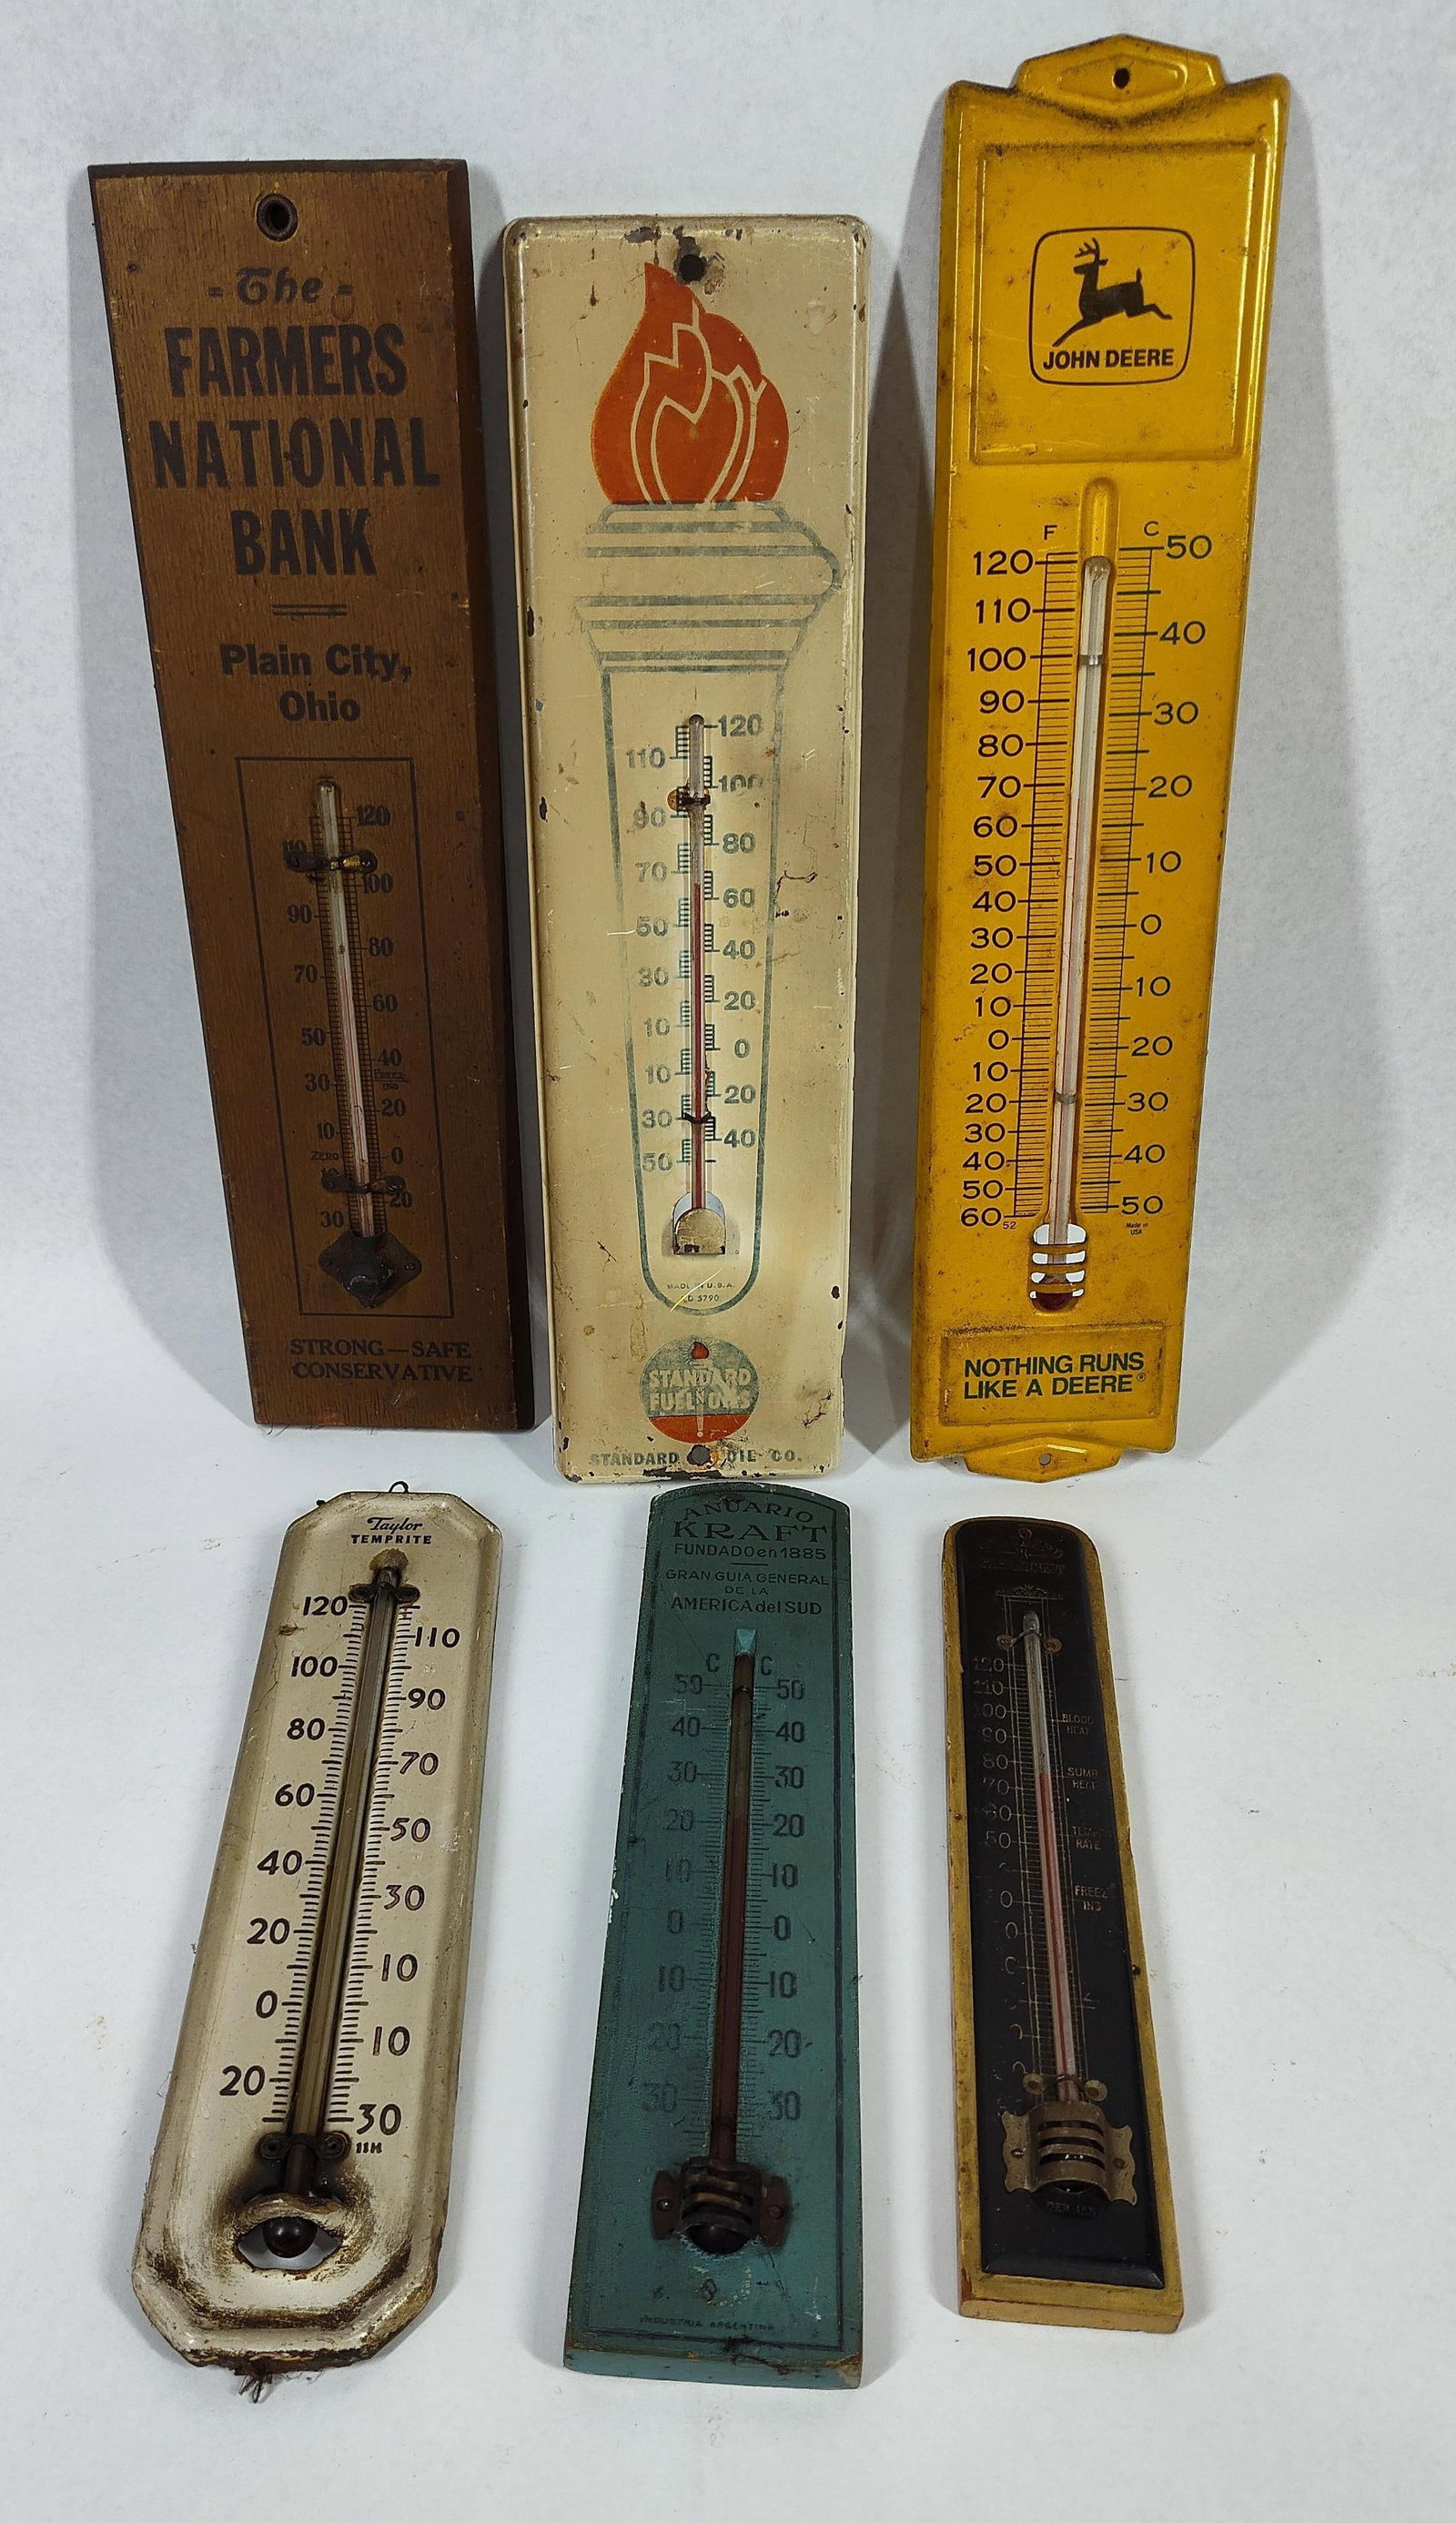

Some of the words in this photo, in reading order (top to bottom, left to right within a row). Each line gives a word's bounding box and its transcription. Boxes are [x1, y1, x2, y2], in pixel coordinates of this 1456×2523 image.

[237, 268, 323, 304] The
[165, 324, 408, 397] FARMERS
[1043, 350, 1100, 370] JOHN
[1105, 349, 1174, 368] DEERE
[148, 418, 441, 489] NATIONAL
[1044, 525, 1057, 540] F
[1144, 521, 1158, 536] C
[230, 509, 378, 576] BANK
[1166, 535, 1212, 560] 50
[973, 549, 1034, 575] 120
[976, 598, 1031, 623] 110
[1159, 621, 1206, 645] 40
[221, 644, 311, 676] Plain
[326, 644, 412, 684] City,
[967, 647, 1026, 672] 100
[279, 691, 361, 723] Ohio
[979, 690, 1025, 714] 90
[1153, 701, 1198, 724] 30
[718, 714, 762, 737] 120
[977, 734, 1024, 757] 80
[626, 747, 666, 769] 110
[977, 775, 1021, 799] 70
[1148, 775, 1192, 798] 20
[357, 805, 390, 826] 120
[633, 806, 666, 829] 90
[973, 816, 1017, 838] 60
[723, 832, 756, 854] 80
[635, 862, 667, 882] 70
[974, 855, 1016, 876] 50
[1147, 851, 1181, 874] 10
[364, 874, 393, 893] 100
[723, 887, 755, 908] 60
[972, 890, 1016, 913] 40
[287, 905, 312, 924] 90
[1140, 914, 1161, 935] 0
[637, 917, 668, 937] 50
[369, 937, 393, 957] 80
[970, 927, 1014, 949] 30
[723, 939, 756, 959] 40
[294, 964, 318, 983] 70
[638, 968, 669, 987] 30
[969, 962, 1013, 984] 20
[1137, 977, 1171, 997] 10
[373, 994, 398, 1012] 60
[724, 990, 756, 1010] 20
[975, 997, 1011, 1018] 10
[301, 1028, 326, 1047] 50
[643, 1018, 670, 1037] 10
[734, 1039, 751, 1058] 0
[988, 1029, 1009, 1049] 0
[1131, 1036, 1173, 1057] 20
[379, 1049, 402, 1066] 40
[644, 1064, 671, 1084] 10
[973, 1061, 1008, 1082] 10
[305, 1074, 330, 1091] 30
[724, 1085, 756, 1104] 20
[965, 1093, 1007, 1113] 20
[1127, 1092, 1169, 1112] 30
[381, 1099, 406, 1117] 20
[642, 1109, 672, 1129] 30
[318, 1122, 334, 1139] 10
[723, 1129, 756, 1148] 40
[964, 1123, 1006, 1143] 30
[390, 1147, 404, 1164] 0
[642, 1153, 672, 1170] 50
[962, 1150, 1005, 1171] 40
[1124, 1144, 1165, 1164] 40
[962, 1180, 1003, 1200] 50
[1121, 1196, 1163, 1215] 50
[320, 1211, 344, 1227] 30
[960, 1208, 1001, 1227] 60
[1002, 1221, 1016, 1230] 52
[293, 1362, 473, 1383] CONSERVATIVE
[965, 1354, 1073, 1377] NOTHING
[1079, 1352, 1144, 1372] RUNS
[649, 1369, 751, 1388] STANDARD
[964, 1382, 1017, 1399] LIKE
[1026, 1379, 1043, 1396] A
[650, 1393, 694, 1411] FUEL
[590, 1451, 680, 1466] STANDARD
[683, 1502, 814, 1523] ANUARIO
[367, 1517, 423, 1535] Taylor
[673, 1521, 827, 1542] KRAFT
[351, 1535, 432, 1545] TEMPRITE
[666, 1570, 710, 1581] GRAN
[715, 1572, 752, 1582] GUIA
[756, 1573, 829, 1586] GENERAL
[303, 1596, 349, 1616] 120
[415, 1627, 460, 1647] 110
[291, 1657, 338, 1677] 100
[409, 1688, 446, 1710] 90
[776, 1679, 804, 1700] 50
[287, 1718, 325, 1740] 80
[672, 1717, 700, 1737] 40
[1062, 1713, 1094, 1724] BLOOD
[776, 1722, 804, 1742] 40
[399, 1752, 439, 1776] 70
[982, 1755, 1008, 1769] 80
[775, 1766, 804, 1788] 30
[275, 1783, 315, 1807] 60
[390, 1818, 430, 1842] 50
[774, 1814, 804, 1837] 20
[257, 1850, 302, 1875] 40
[773, 1863, 799, 1889] 10
[384, 1884, 425, 1910] 30
[247, 1918, 290, 1944] 20
[774, 1915, 792, 1940] 0
[382, 1954, 418, 1981] 10
[769, 1971, 797, 1998] 10
[256, 1991, 278, 2019] 0
[373, 2026, 410, 2056] 10
[767, 2030, 802, 2058] 20
[219, 2065, 266, 2096] 20
[357, 2103, 401, 2135] 30
